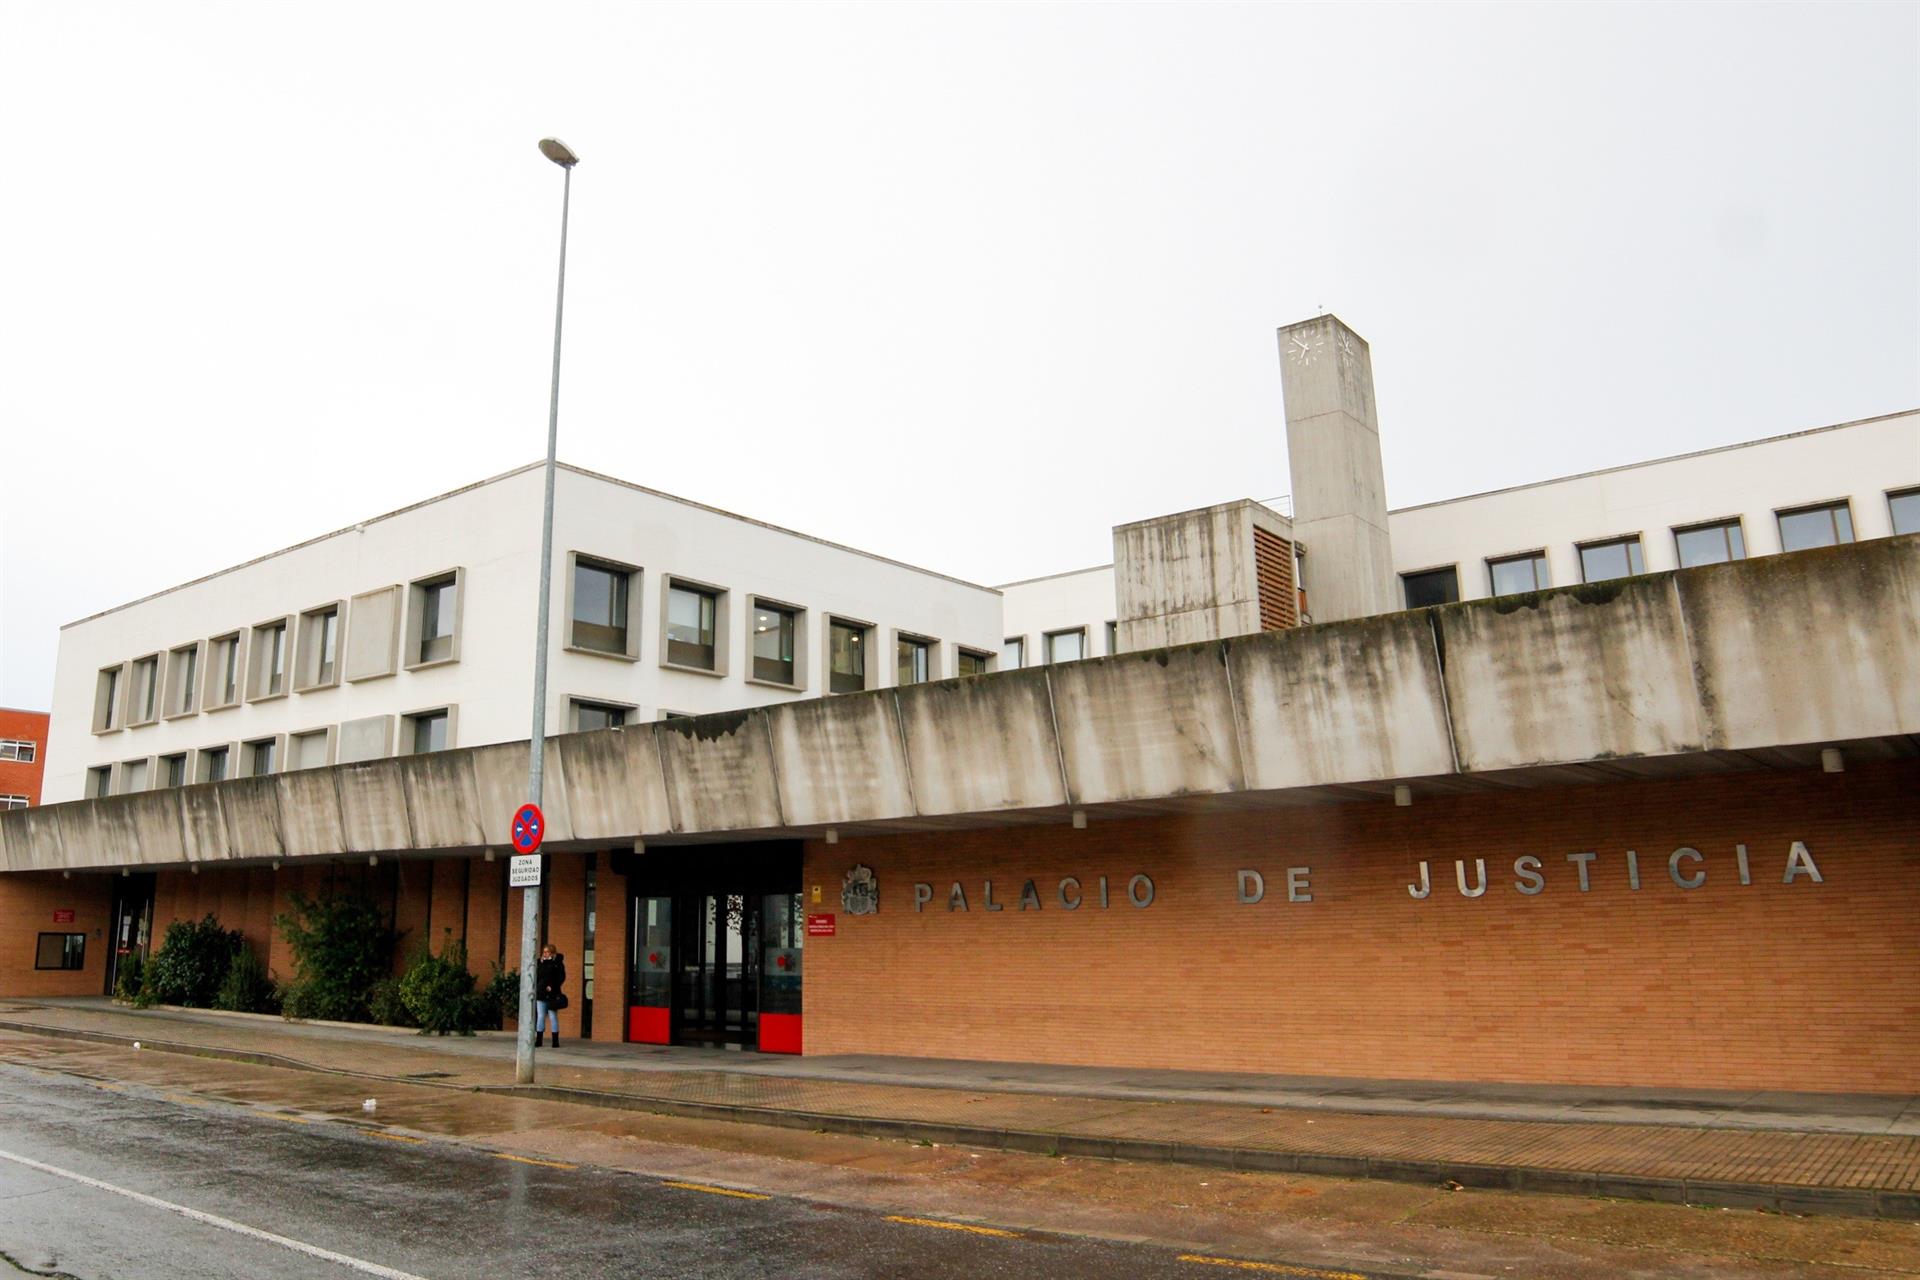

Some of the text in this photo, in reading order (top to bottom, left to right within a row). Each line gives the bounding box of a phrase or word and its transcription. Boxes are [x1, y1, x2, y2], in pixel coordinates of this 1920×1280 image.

[512, 867, 539, 875] SEGURIDAD
[914, 840, 1824, 913] PALACIO DE JUSTICIA
